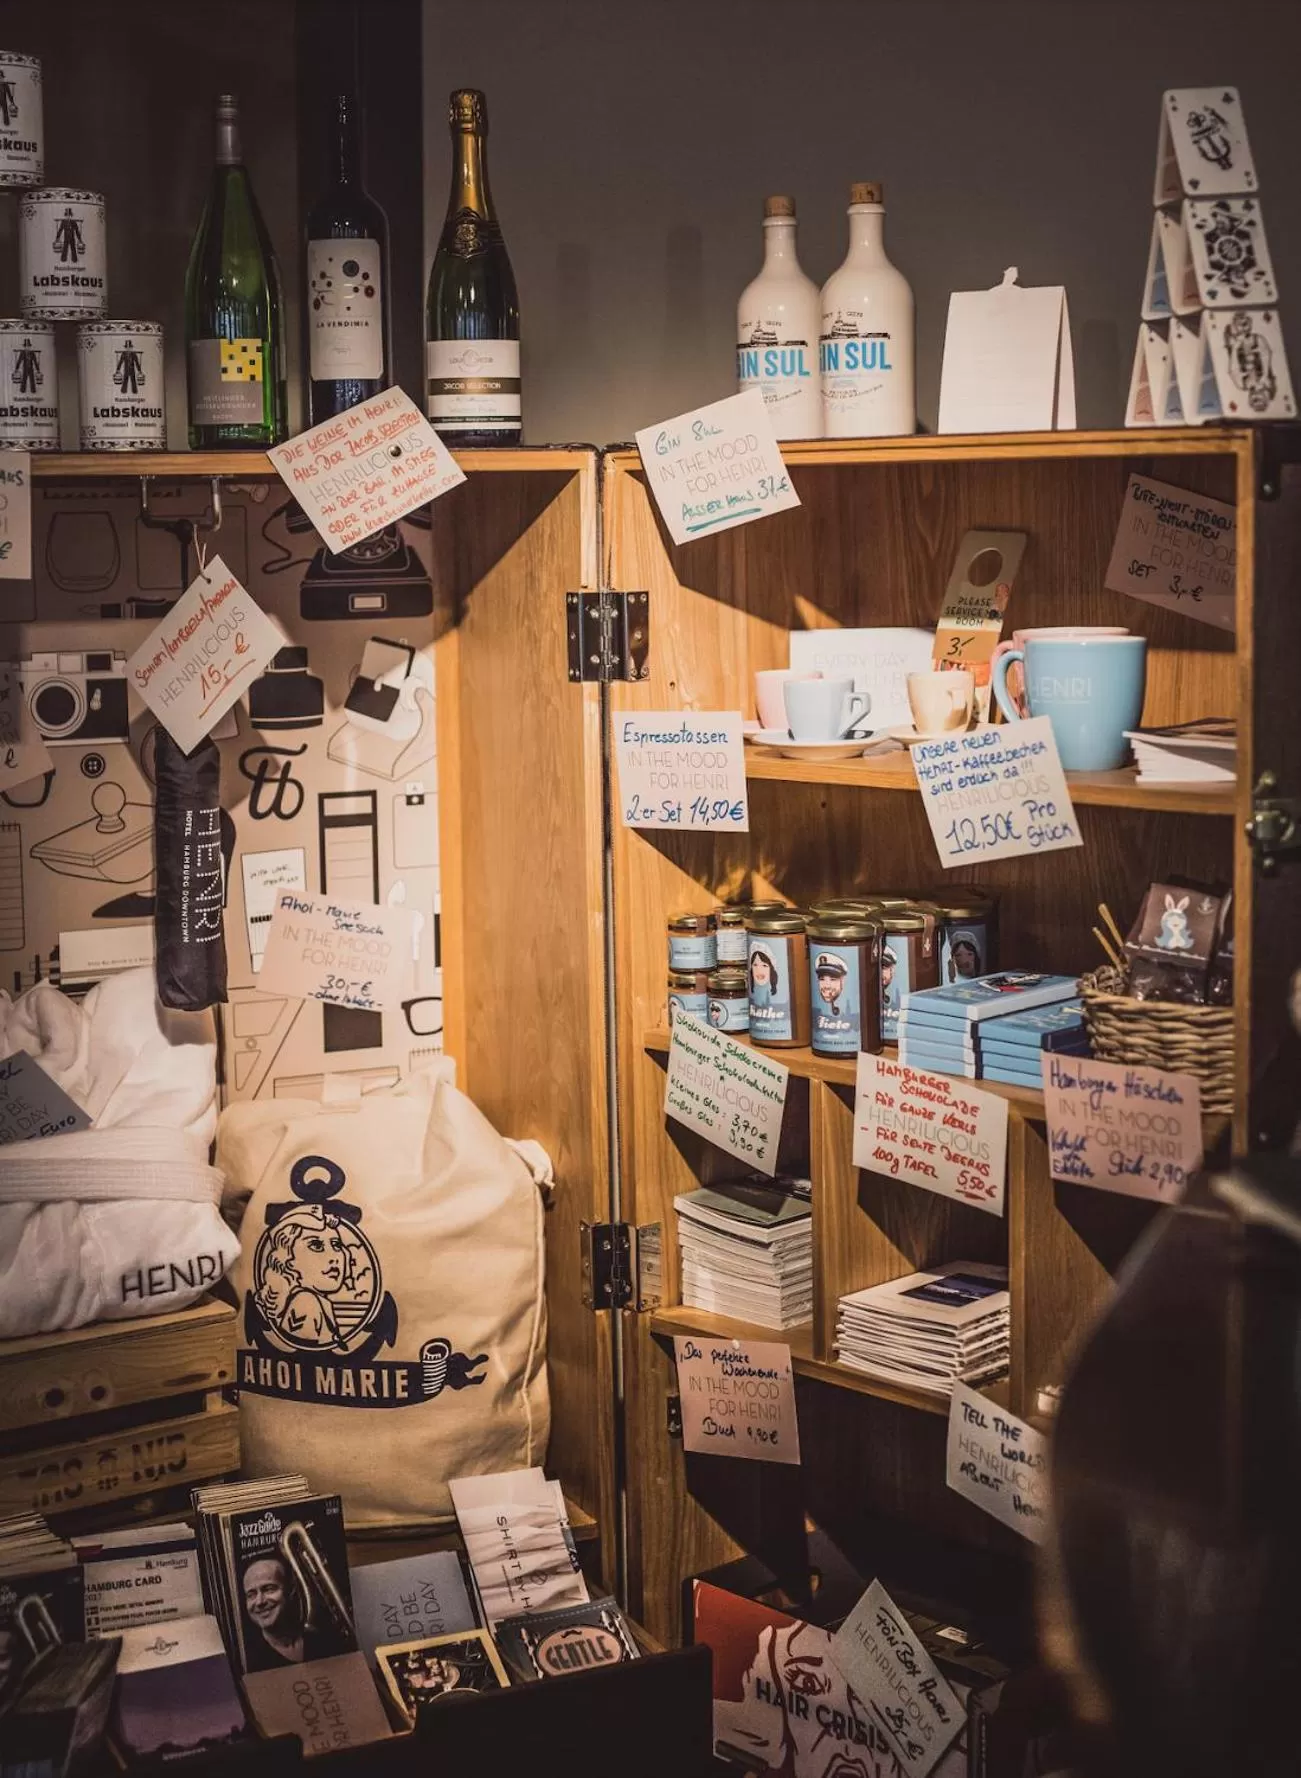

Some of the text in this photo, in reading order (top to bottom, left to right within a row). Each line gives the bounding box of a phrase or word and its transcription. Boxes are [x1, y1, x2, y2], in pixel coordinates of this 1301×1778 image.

[33, 274, 103, 288] Labskaus
[764, 349, 811, 377] SUL
[845, 341, 892, 371] SUL
[93, 405, 163, 418] Labskaus
[658, 433, 759, 482] IN THE MOOD
[686, 455, 768, 497] FOR HENRI
[1130, 515, 1148, 535] IN
[1153, 524, 1182, 547] THE
[1128, 559, 1157, 579] SET
[1151, 545, 1185, 570] FOR
[944, 605, 985, 617] SERVICE
[957, 596, 992, 606] PLEASE
[158, 605, 246, 709] HENRILICIOUS
[1035, 677, 1091, 698] HENRI
[623, 720, 728, 748] Espressotassen
[627, 751, 729, 769] IN THE MOOD
[649, 772, 729, 790] FOR HENRI
[937, 774, 1050, 814] HENRILICIOUS
[180, 810, 193, 944] HOTEL HAMBURG DOWNTOWN
[195, 806, 222, 943] HENRI
[281, 924, 393, 957] IN THE MOOD
[301, 946, 389, 977] FOR HENRI
[677, 1059, 769, 1122] HENRILICIOUS
[875, 1060, 952, 1095] HAMBURGER
[875, 1091, 895, 1107] FÜR
[869, 1106, 990, 1160] HENRILICIOUS
[1058, 1097, 1181, 1137] IN THE MOOD
[876, 1126, 898, 1143] FÜR
[1085, 1125, 1183, 1160] FOR HENRI
[872, 1146, 900, 1174] 100g
[903, 1155, 939, 1179] TAFEL
[119, 1250, 226, 1302] HENRI
[243, 1354, 409, 1399] AHOI MARIE
[688, 1376, 780, 1400] IN THE MOOD
[708, 1398, 781, 1421] FOR HENRI
[961, 1401, 1023, 1442] TELL THE
[495, 1515, 524, 1571] SHIRT
[134, 1574, 163, 1587] CARD
[416, 1579, 442, 1615] DAY
[379, 1602, 405, 1638] DAY
[547, 1636, 614, 1671] GENTLE
[854, 1621, 936, 1743] HENRILICIOUS
[292, 1678, 325, 1738] MOOD
[755, 1678, 892, 1752] HAIR CRISIS
